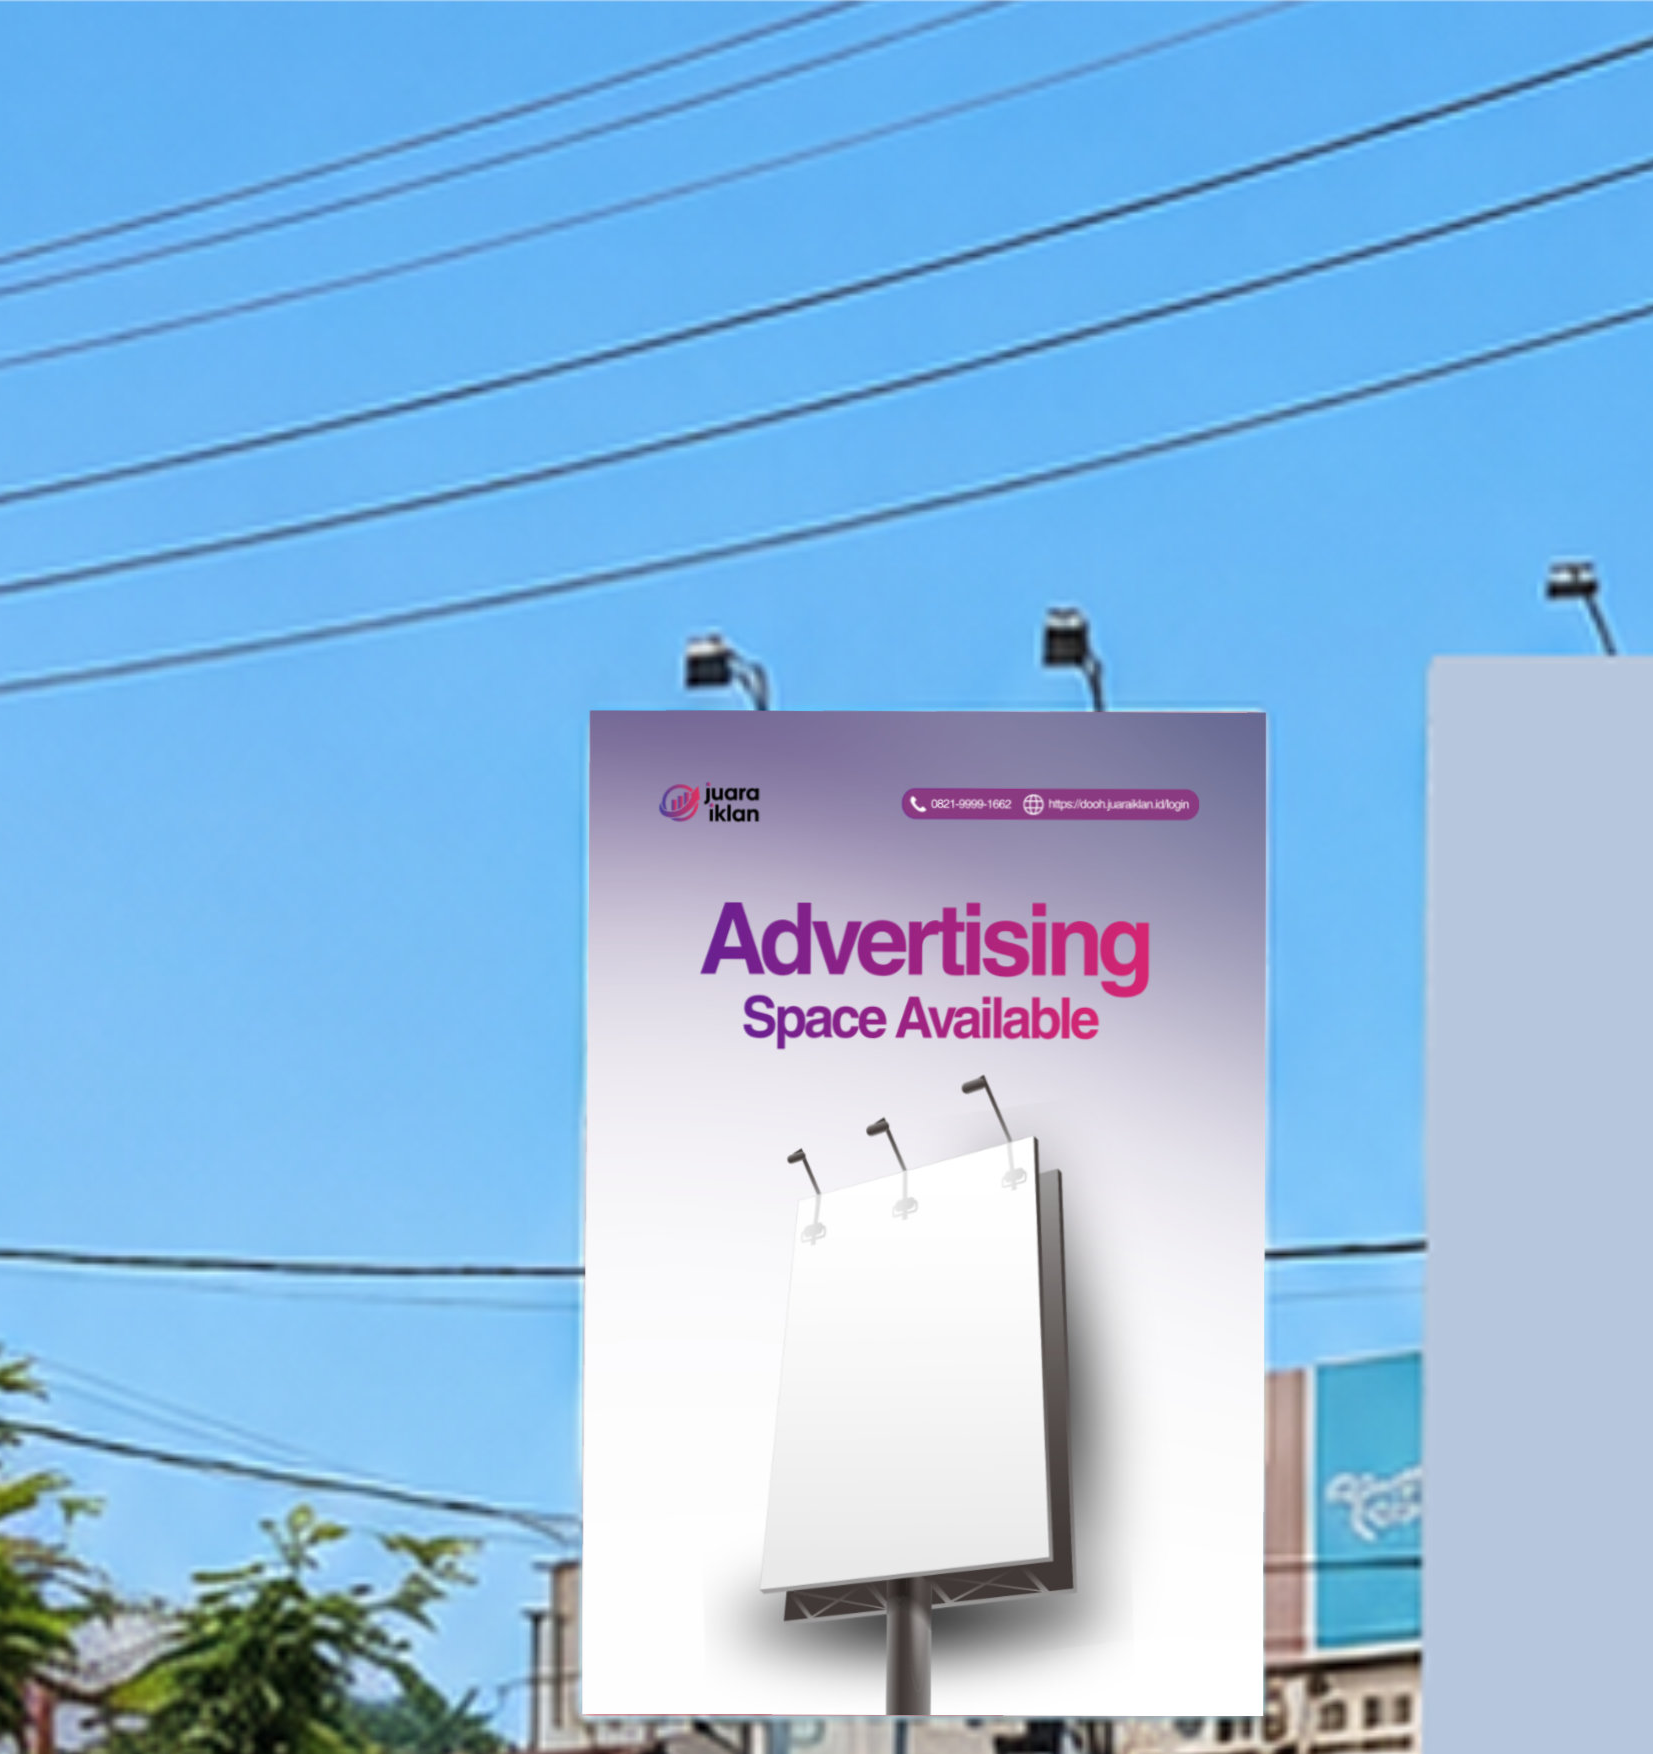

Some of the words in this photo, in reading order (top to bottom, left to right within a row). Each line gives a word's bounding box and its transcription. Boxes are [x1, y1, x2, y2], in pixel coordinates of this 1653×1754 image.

[704, 782, 759, 805] juara
[930, 798, 1012, 810] 0821-9999-1662
[709, 802, 759, 822] iklan
[701, 902, 1150, 997] Advertising
[743, 995, 887, 1048] Space
[895, 997, 1100, 1040] Available
